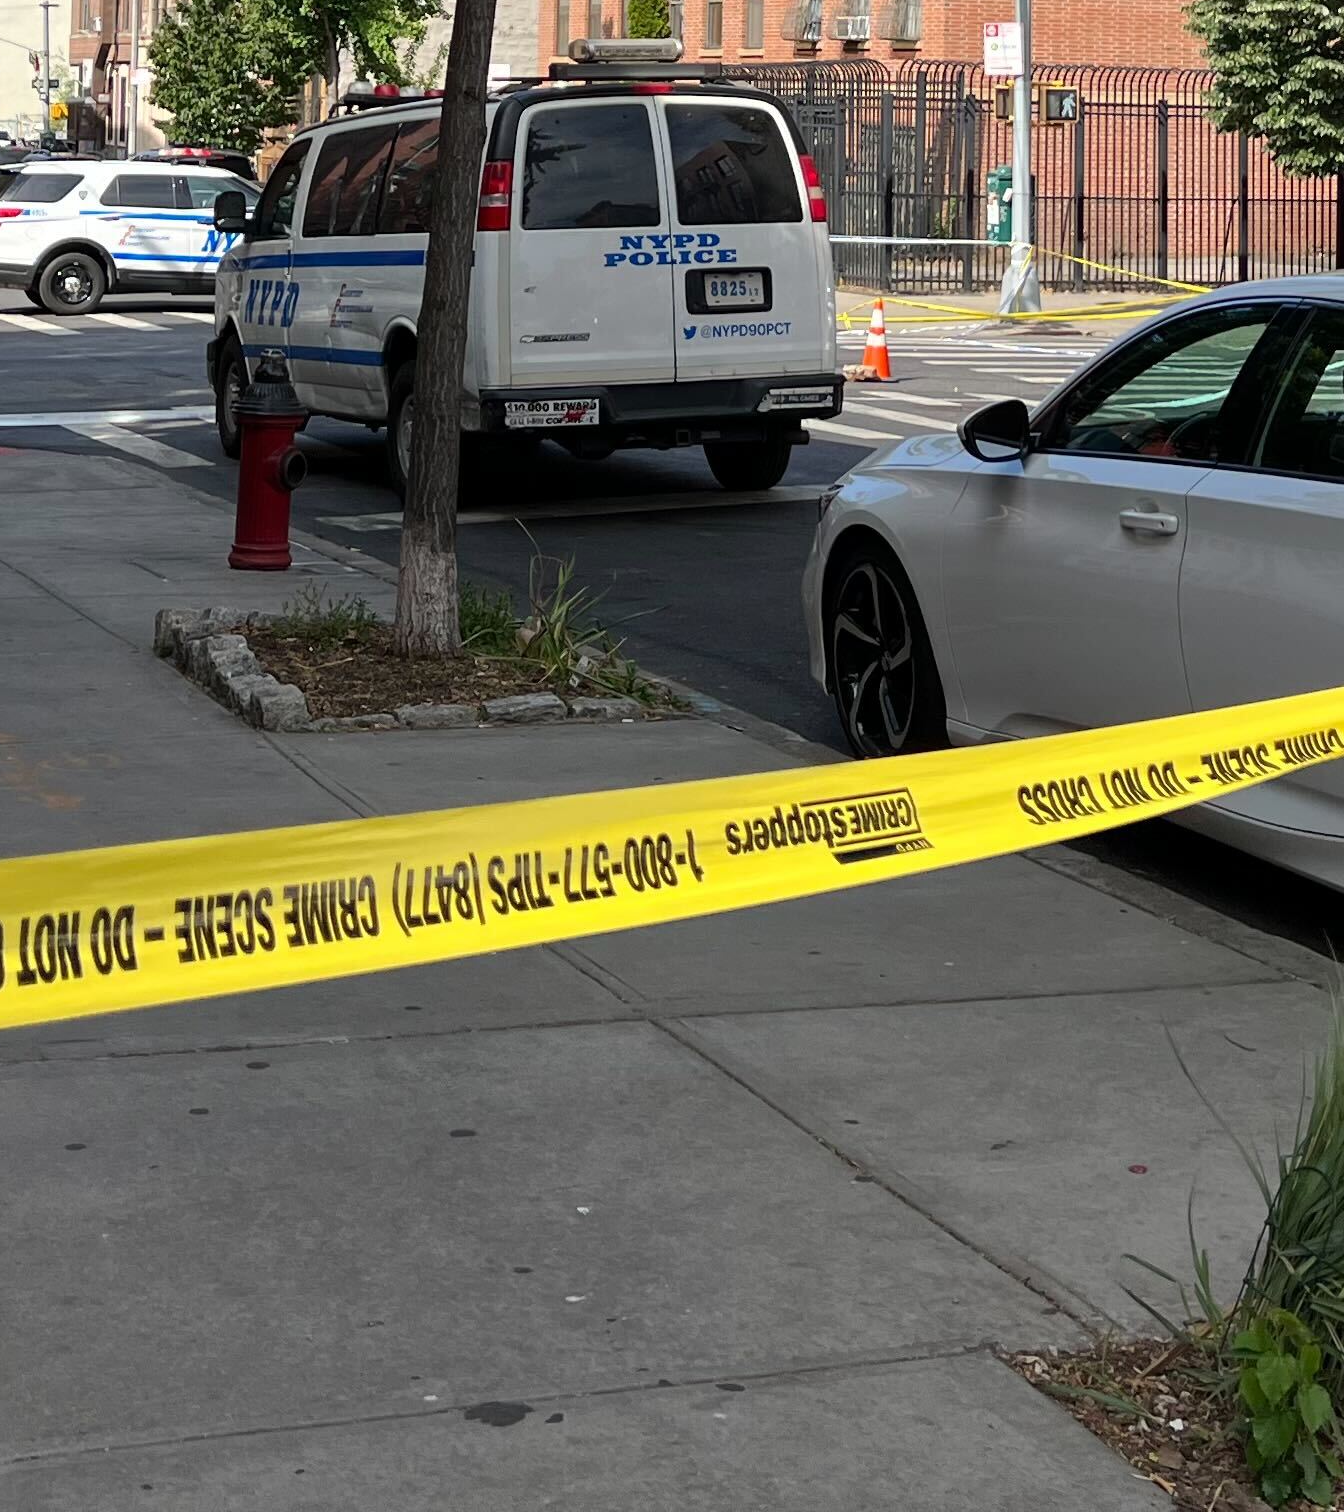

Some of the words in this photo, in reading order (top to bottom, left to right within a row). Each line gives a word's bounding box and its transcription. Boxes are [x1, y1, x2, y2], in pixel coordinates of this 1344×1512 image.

[201, 229, 244, 252] NY
[604, 249, 737, 267] POLICE
[619, 233, 721, 250] NYPD
[244, 279, 300, 327] NYPD
[710, 280, 748, 297] 8825
[700, 322, 792, 339] @NYPD90PCT
[1147, 761, 1192, 798] DO
[1200, 743, 1281, 786] SCENE
[1017, 775, 1107, 826] CROSS
[1099, 767, 1154, 809] NOT
[284, 874, 380, 948] CRIME
[393, 852, 486, 937] (8477)
[90, 905, 138, 976] DO
[174, 887, 277, 964] SCENE
[17, 910, 84, 987] NOT
